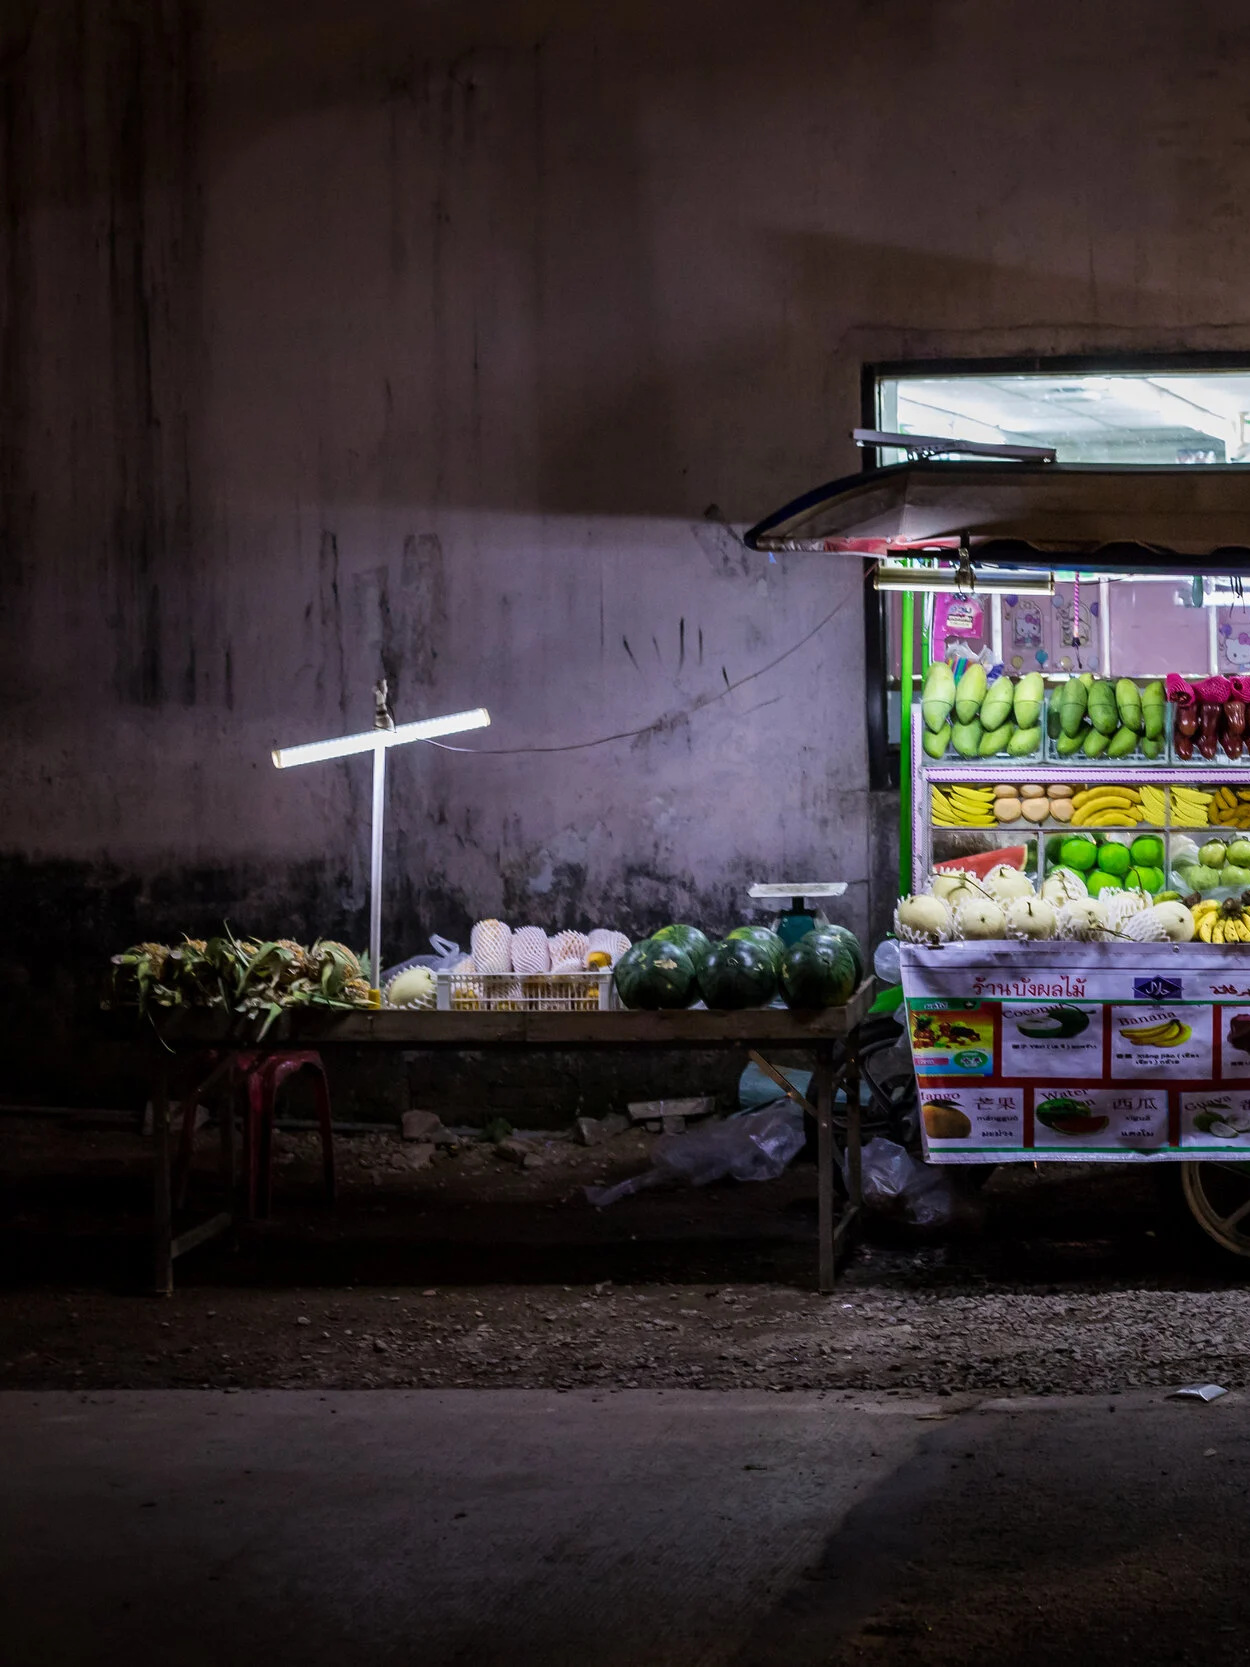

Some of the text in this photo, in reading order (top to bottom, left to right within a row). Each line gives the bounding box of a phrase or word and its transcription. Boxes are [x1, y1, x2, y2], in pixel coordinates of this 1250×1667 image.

[973, 975, 1087, 998] ร้านบังผลไม้
[1003, 1003, 1065, 1019] Coconut
[1117, 1011, 1177, 1027] Banana
[974, 1096, 1017, 1111] 芒果
[1041, 1089, 1088, 1102] Water
[1111, 1097, 1158, 1110] 西瓜
[1184, 1095, 1233, 1113] Guava
